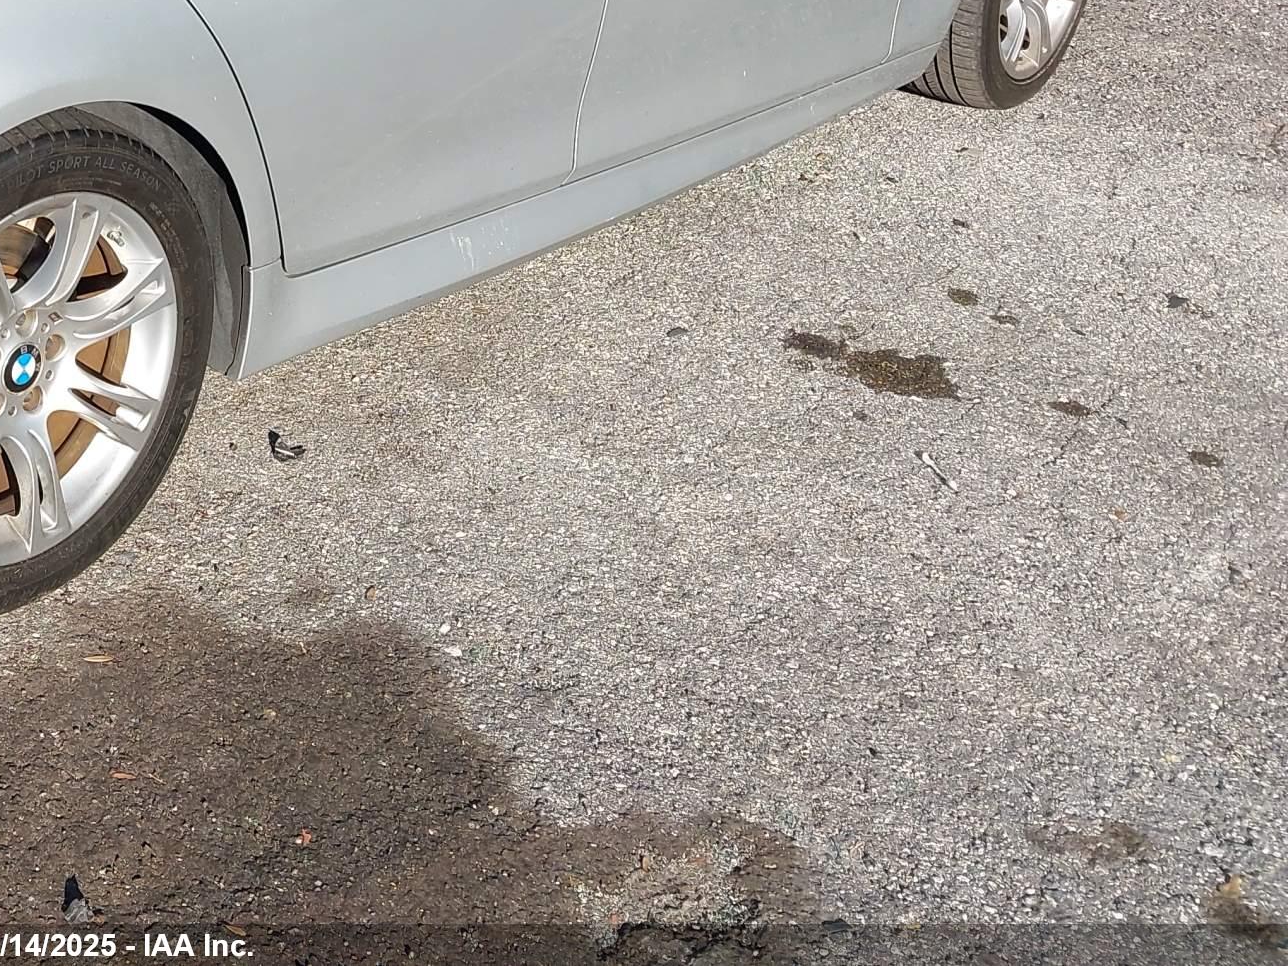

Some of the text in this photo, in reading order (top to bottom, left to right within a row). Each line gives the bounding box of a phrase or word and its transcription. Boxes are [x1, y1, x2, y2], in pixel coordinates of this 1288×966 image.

[48, 155, 91, 174] SPORT
[95, 156, 116, 170] ALL
[120, 161, 162, 192] SEASON
